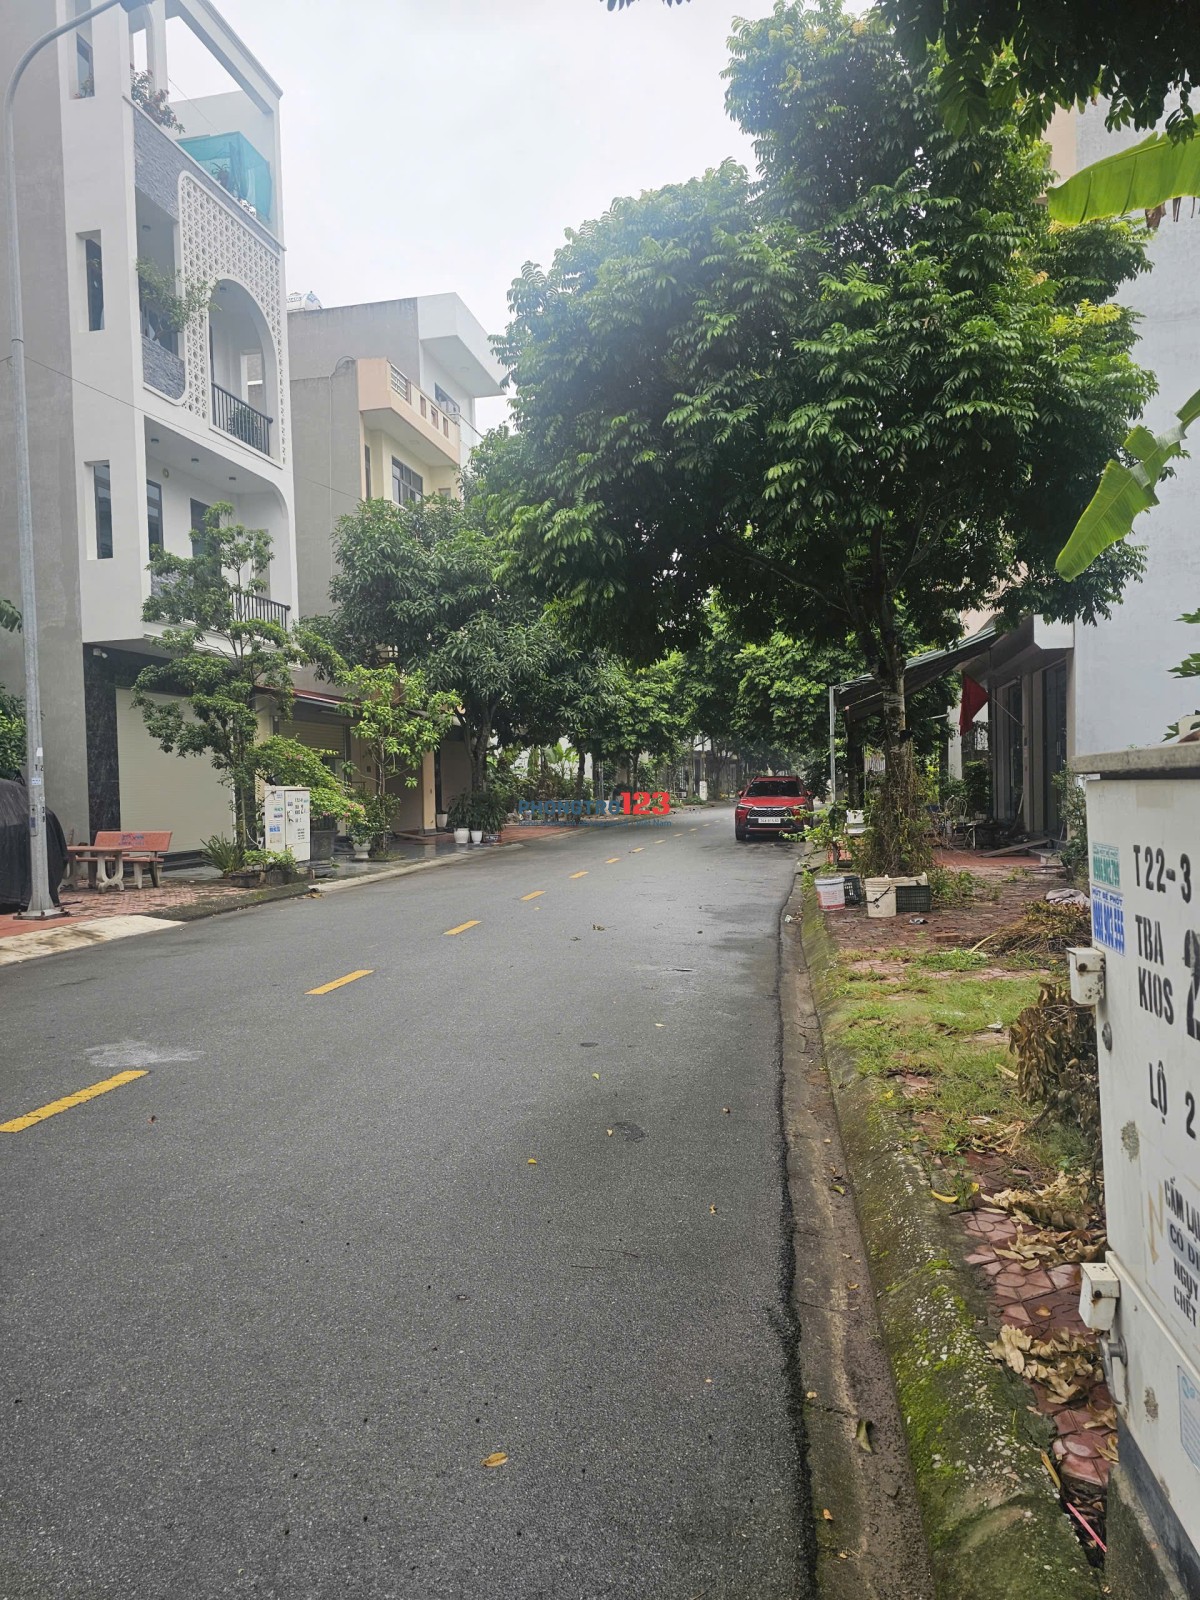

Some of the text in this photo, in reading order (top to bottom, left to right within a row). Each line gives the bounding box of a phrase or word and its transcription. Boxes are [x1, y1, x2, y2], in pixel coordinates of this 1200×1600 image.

[1135, 914, 1164, 966] TBA
[1138, 965, 1175, 1026] KIOS
[1149, 1059, 1197, 1140] LỘ 2
